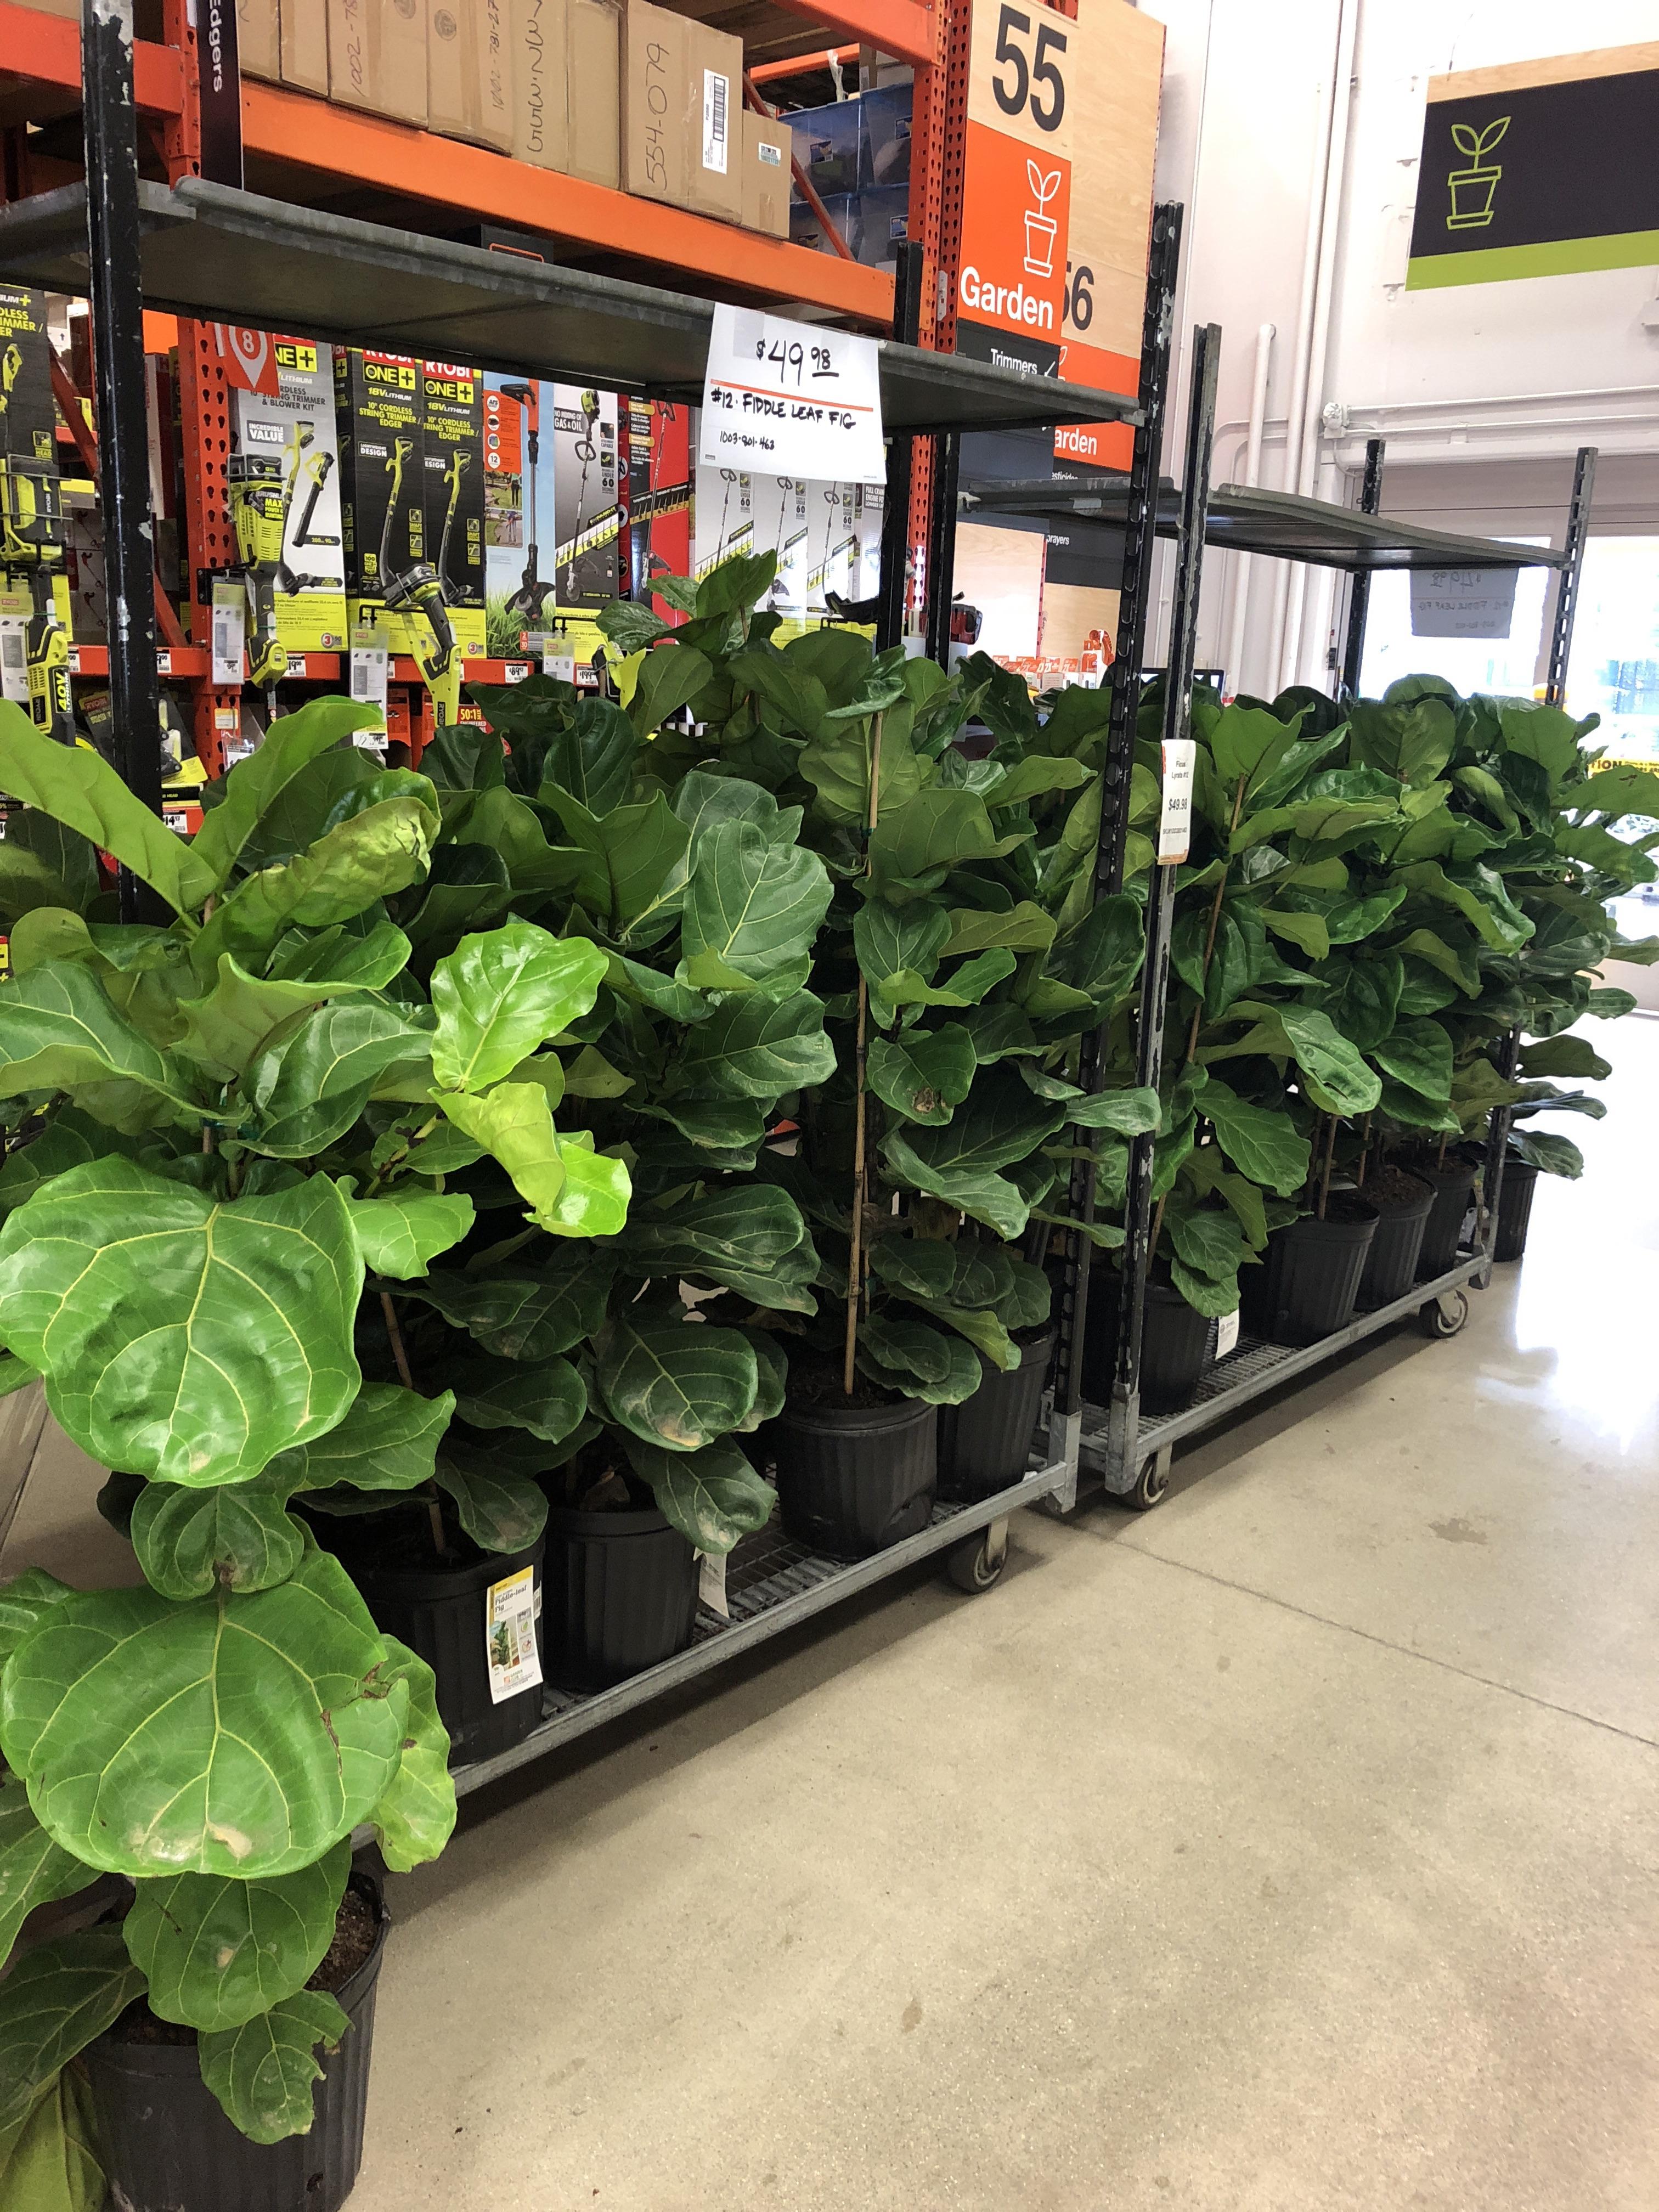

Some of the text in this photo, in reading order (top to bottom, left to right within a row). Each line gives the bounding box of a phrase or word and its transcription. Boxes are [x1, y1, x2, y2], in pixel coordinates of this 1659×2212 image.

[992, 3, 1068, 132] 55
[961, 266, 1053, 330] Garden
[242, 330, 255, 353] 8
[991, 349, 1037, 375] Trimmers
[270, 399, 300, 409] BLOWER
[292, 394, 325, 405] TRIMMER
[379, 404, 413, 415] CORDLESS
[743, 393, 786, 417] FIDDLE
[791, 404, 823, 423] LEAF
[829, 411, 856, 429] FIG
[359, 408, 384, 419] STRING
[386, 412, 416, 423] TRIMMER
[249, 423, 284, 431] INCREDIBLE
[380, 419, 402, 428] EDGER
[438, 417, 470, 428] CORDLESS
[555, 419, 567, 428] GAS
[572, 421, 582, 431] OIL
[250, 429, 284, 442] VALUE
[439, 432, 460, 441] EDGER
[445, 425, 475, 437] TRIMMER
[360, 448, 387, 458] DESIGN
[602, 478, 614, 487] 60
[265, 498, 283, 507] MAX
[741, 498, 750, 506] 60
[796, 505, 805, 514] 60
[843, 516, 852, 524] 60
[324, 636, 331, 644] 3
[55, 672, 66, 711] 40V
[1169, 798, 1188, 811] $49.98
